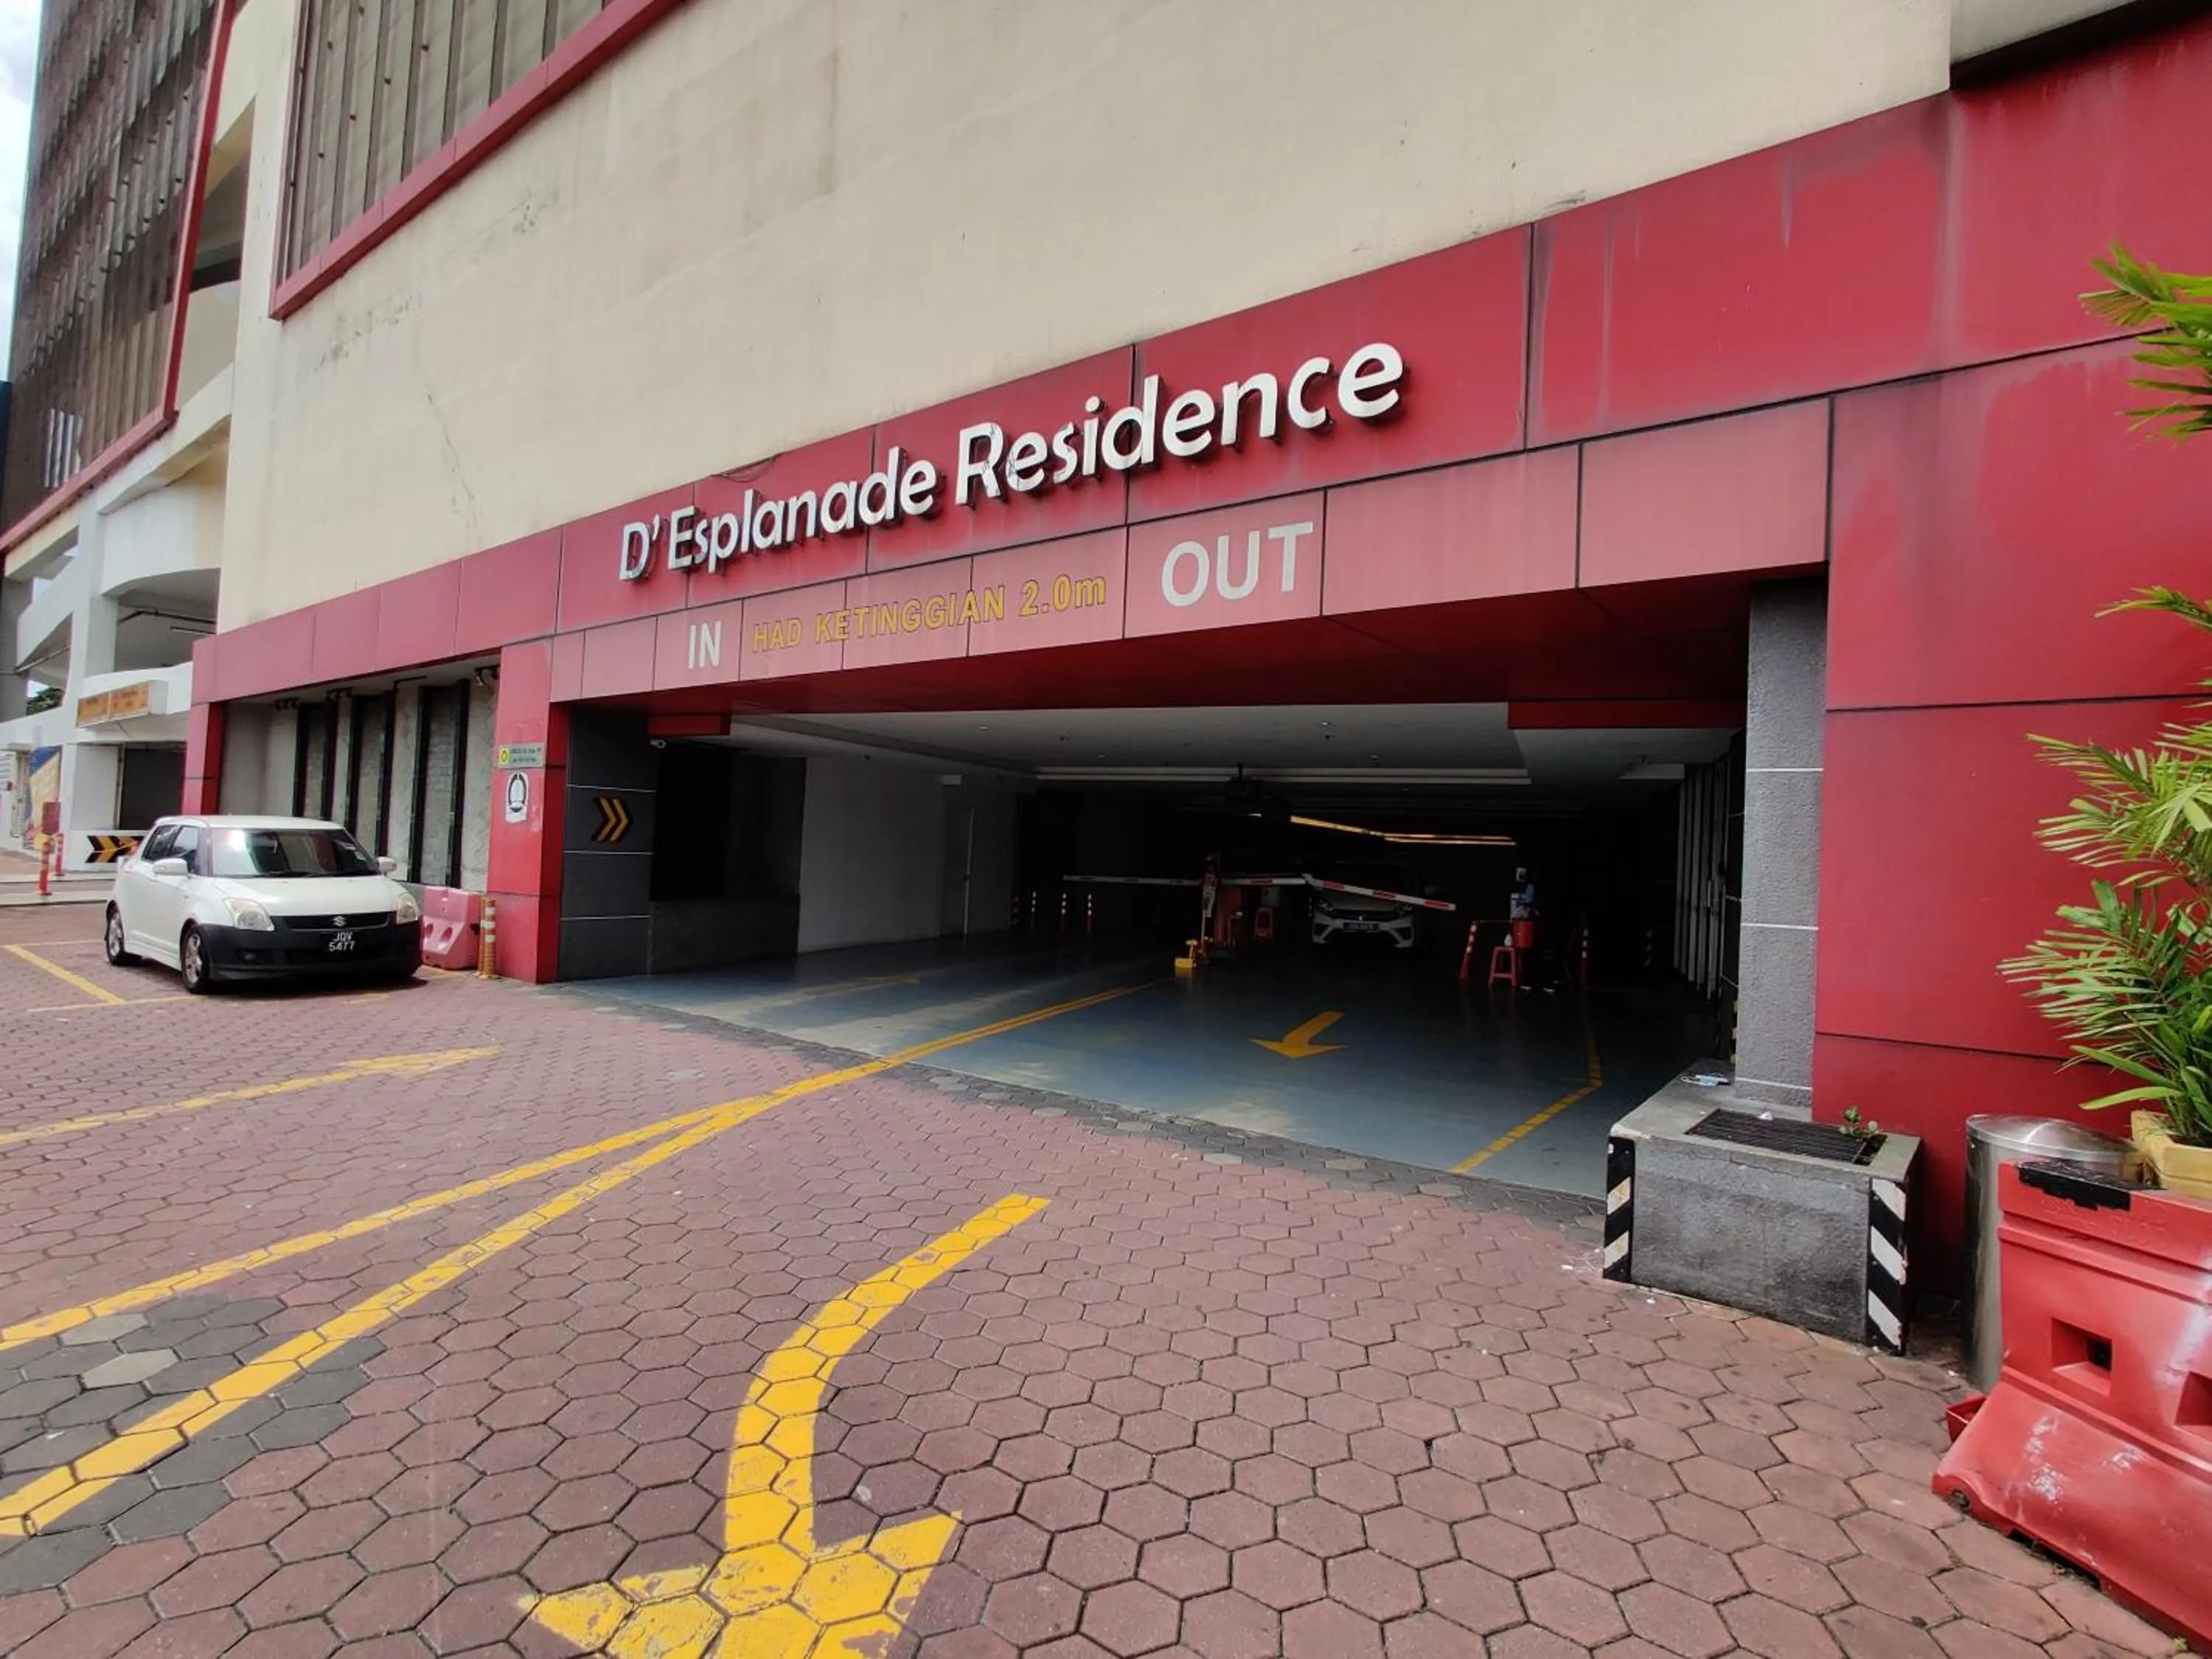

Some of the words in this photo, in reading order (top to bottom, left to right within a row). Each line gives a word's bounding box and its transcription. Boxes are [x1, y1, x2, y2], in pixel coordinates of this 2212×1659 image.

[956, 342, 1403, 504] Residence
[1161, 521, 1313, 607] OUT
[688, 620, 721, 669] IN
[752, 618, 803, 653] HAD
[815, 585, 1005, 644] KETINGGIAN
[1019, 574, 1106, 617] 2.0m
